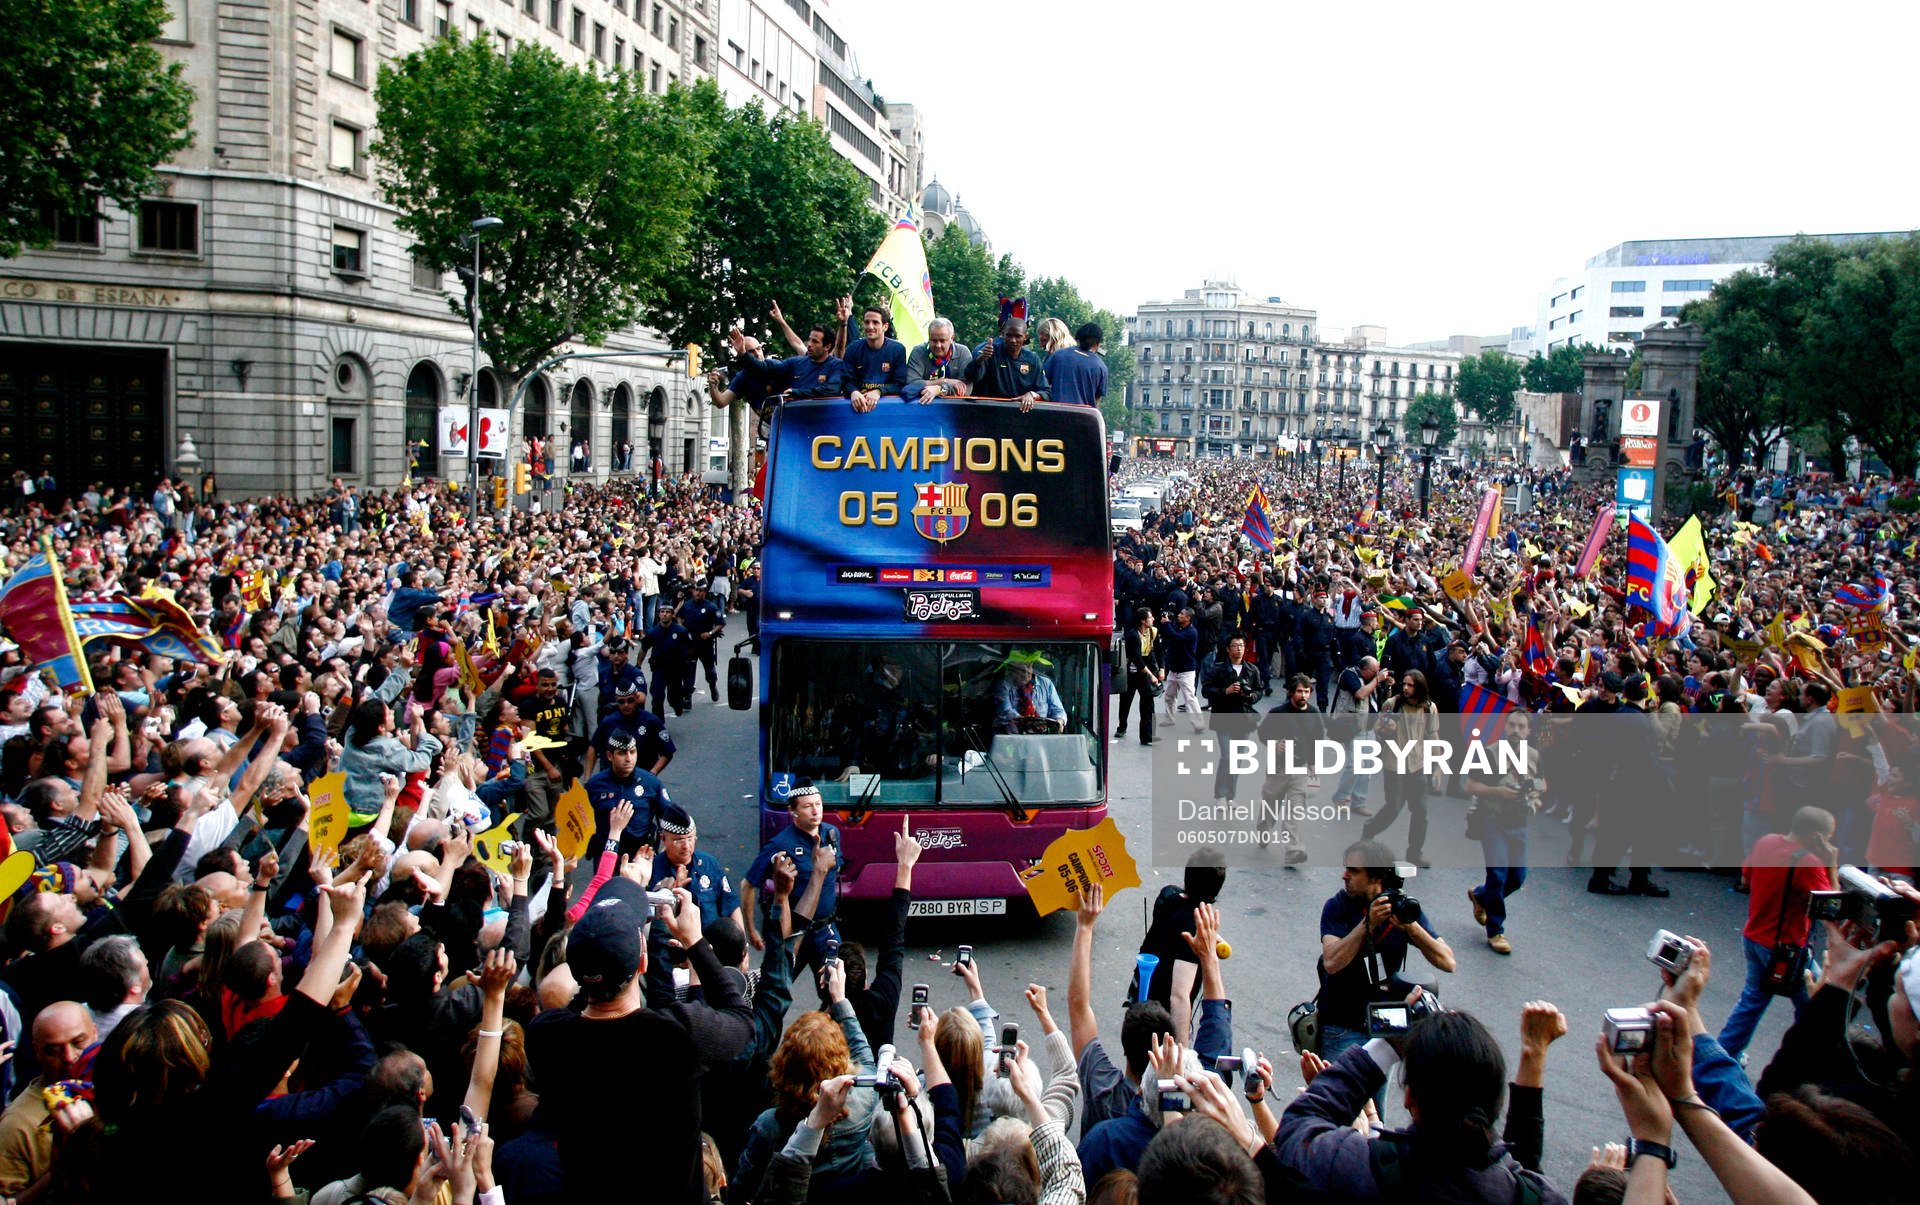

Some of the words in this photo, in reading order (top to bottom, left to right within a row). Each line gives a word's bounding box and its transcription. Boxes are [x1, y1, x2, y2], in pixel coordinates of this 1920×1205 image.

[57, 289, 75, 300] DE
[811, 435, 1066, 473] CAMPIONS
[839, 490, 898, 526] 05
[980, 492, 1038, 527] 06
[1627, 583, 1650, 602] FC
[1092, 845, 1114, 878] SPORT
[1058, 863, 1079, 894] 05-06
[912, 903, 942, 915] 7880
[948, 902, 971, 914] BYR
